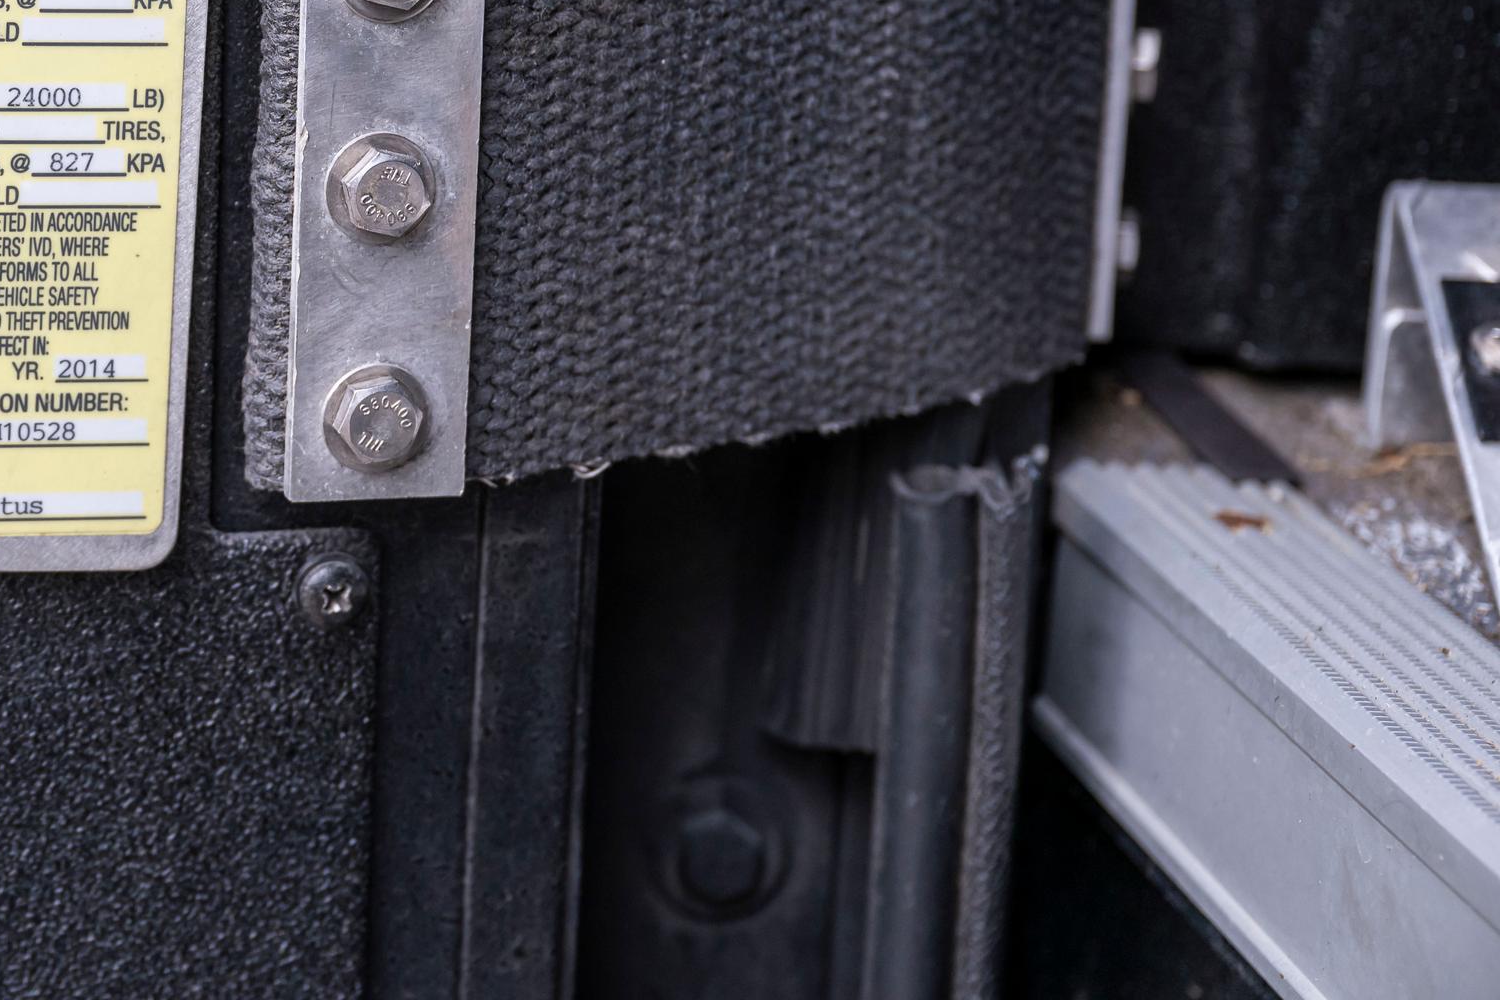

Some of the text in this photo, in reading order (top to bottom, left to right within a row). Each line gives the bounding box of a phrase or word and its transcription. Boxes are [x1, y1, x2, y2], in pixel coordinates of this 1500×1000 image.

[7, 88, 81, 107] 24000
[133, 89, 164, 113] LB)
[103, 121, 165, 143] TIRES,
[10, 154, 30, 173] @
[50, 153, 94, 171] 827
[127, 154, 165, 173] KPA
[31, 213, 44, 231] IN
[47, 212, 137, 231] ACCORDANCE
[29, 237, 55, 259] IVD,
[60, 237, 109, 256] WHERE
[52, 262, 69, 281] TO
[73, 262, 98, 281] ALL
[48, 287, 99, 306] SAFETY
[6, 312, 45, 330] THEFT
[49, 311, 129, 330] PREVENTION
[32, 336, 49, 355] IN:
[12, 361, 44, 380] YR.
[59, 360, 116, 378] 2014
[35, 393, 128, 412] NUMBER:
